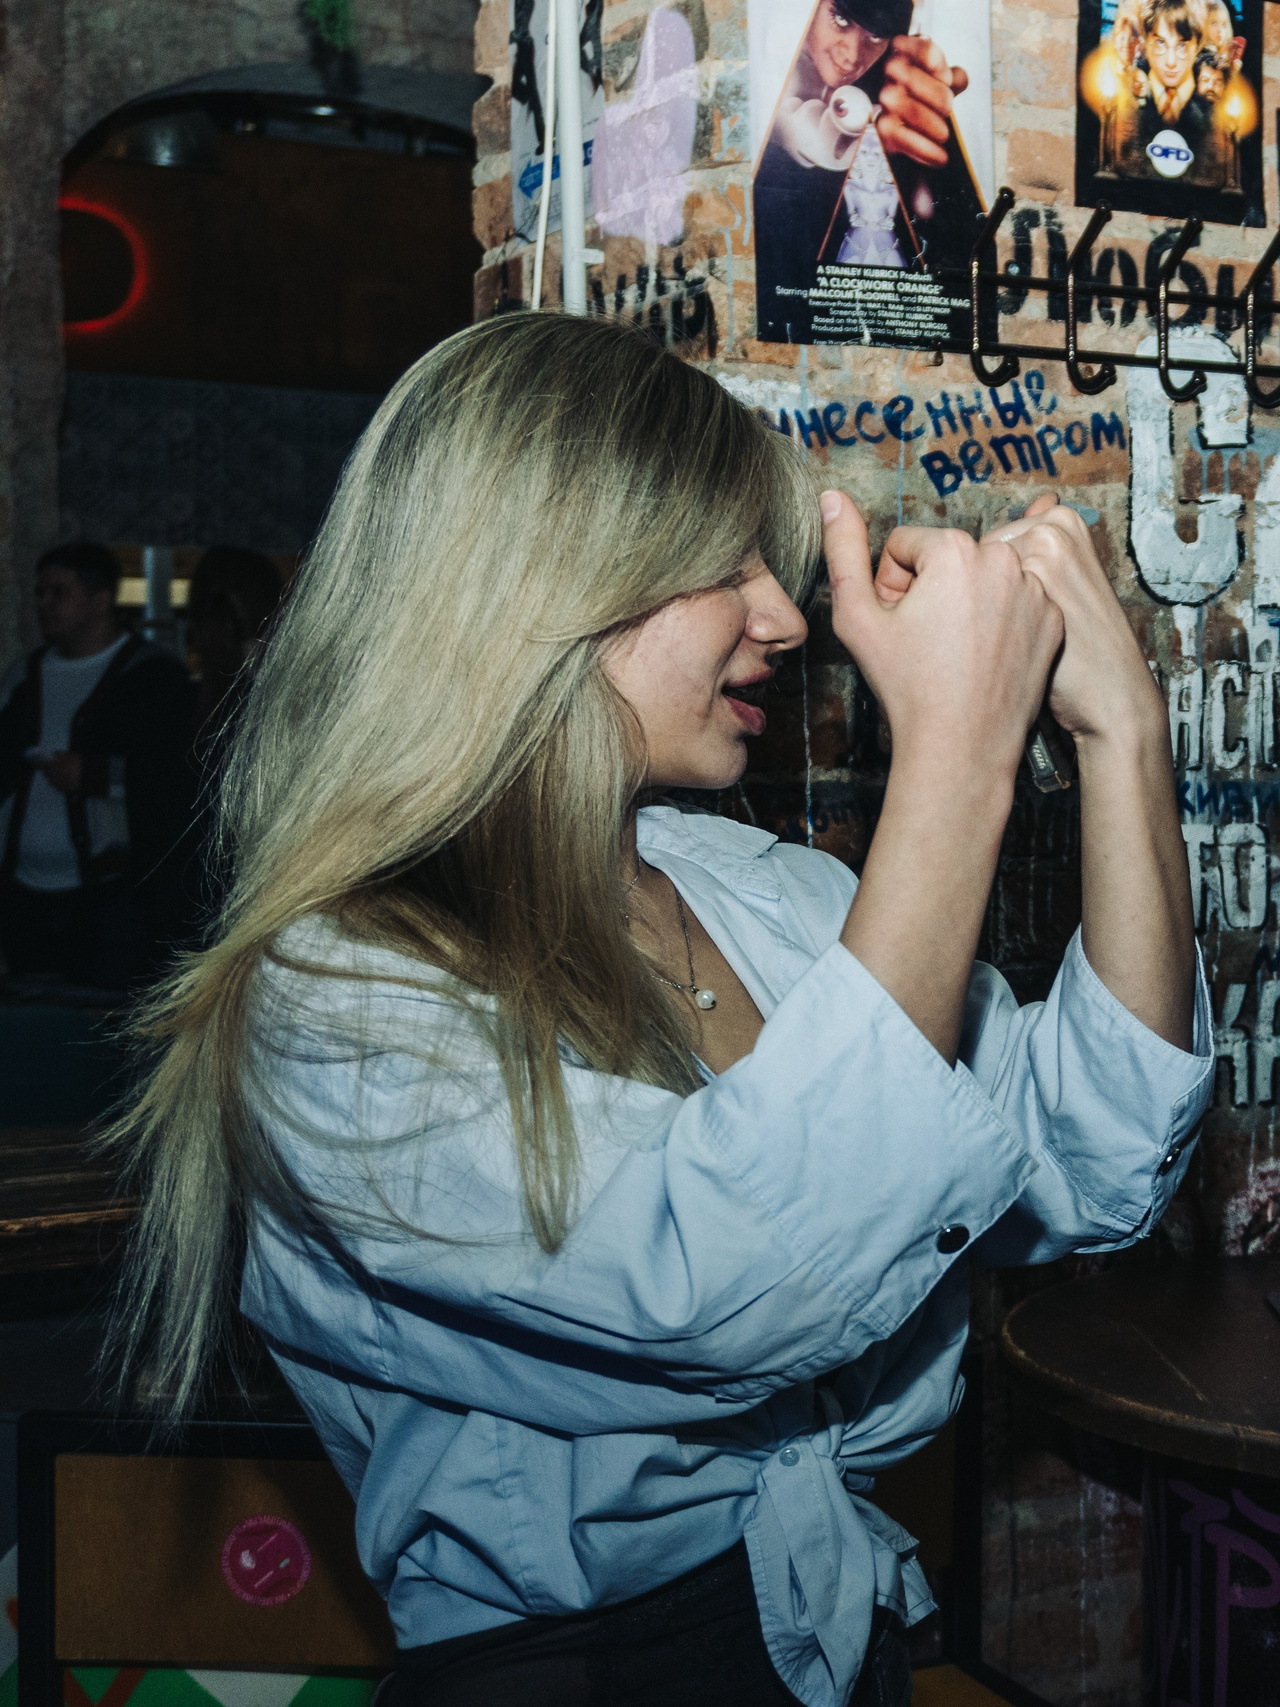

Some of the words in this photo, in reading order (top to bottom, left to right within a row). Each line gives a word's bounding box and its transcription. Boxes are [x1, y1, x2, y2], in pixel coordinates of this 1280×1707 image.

[1149, 144, 1191, 161] OFD
[816, 265, 824, 274] A
[825, 265, 861, 276] STANLEY
[863, 268, 899, 279] KUBRICK
[899, 270, 933, 281] Product
[829, 277, 895, 292] CLOCKWORK
[775, 285, 808, 298] Starring
[808, 288, 854, 299] MALCOLM
[901, 294, 917, 303] and
[917, 295, 949, 306] PATRICK
[950, 298, 971, 308] MAG
[808, 299, 836, 307] Executive
[829, 307, 867, 317] Screenplay
[877, 310, 904, 318] STANLEY
[811, 323, 843, 332] Produced
[895, 328, 923, 336] STANLEY
[813, 315, 835, 323] Based
[885, 319, 918, 328] ANTHONY
[919, 321, 948, 330] BURGESS
